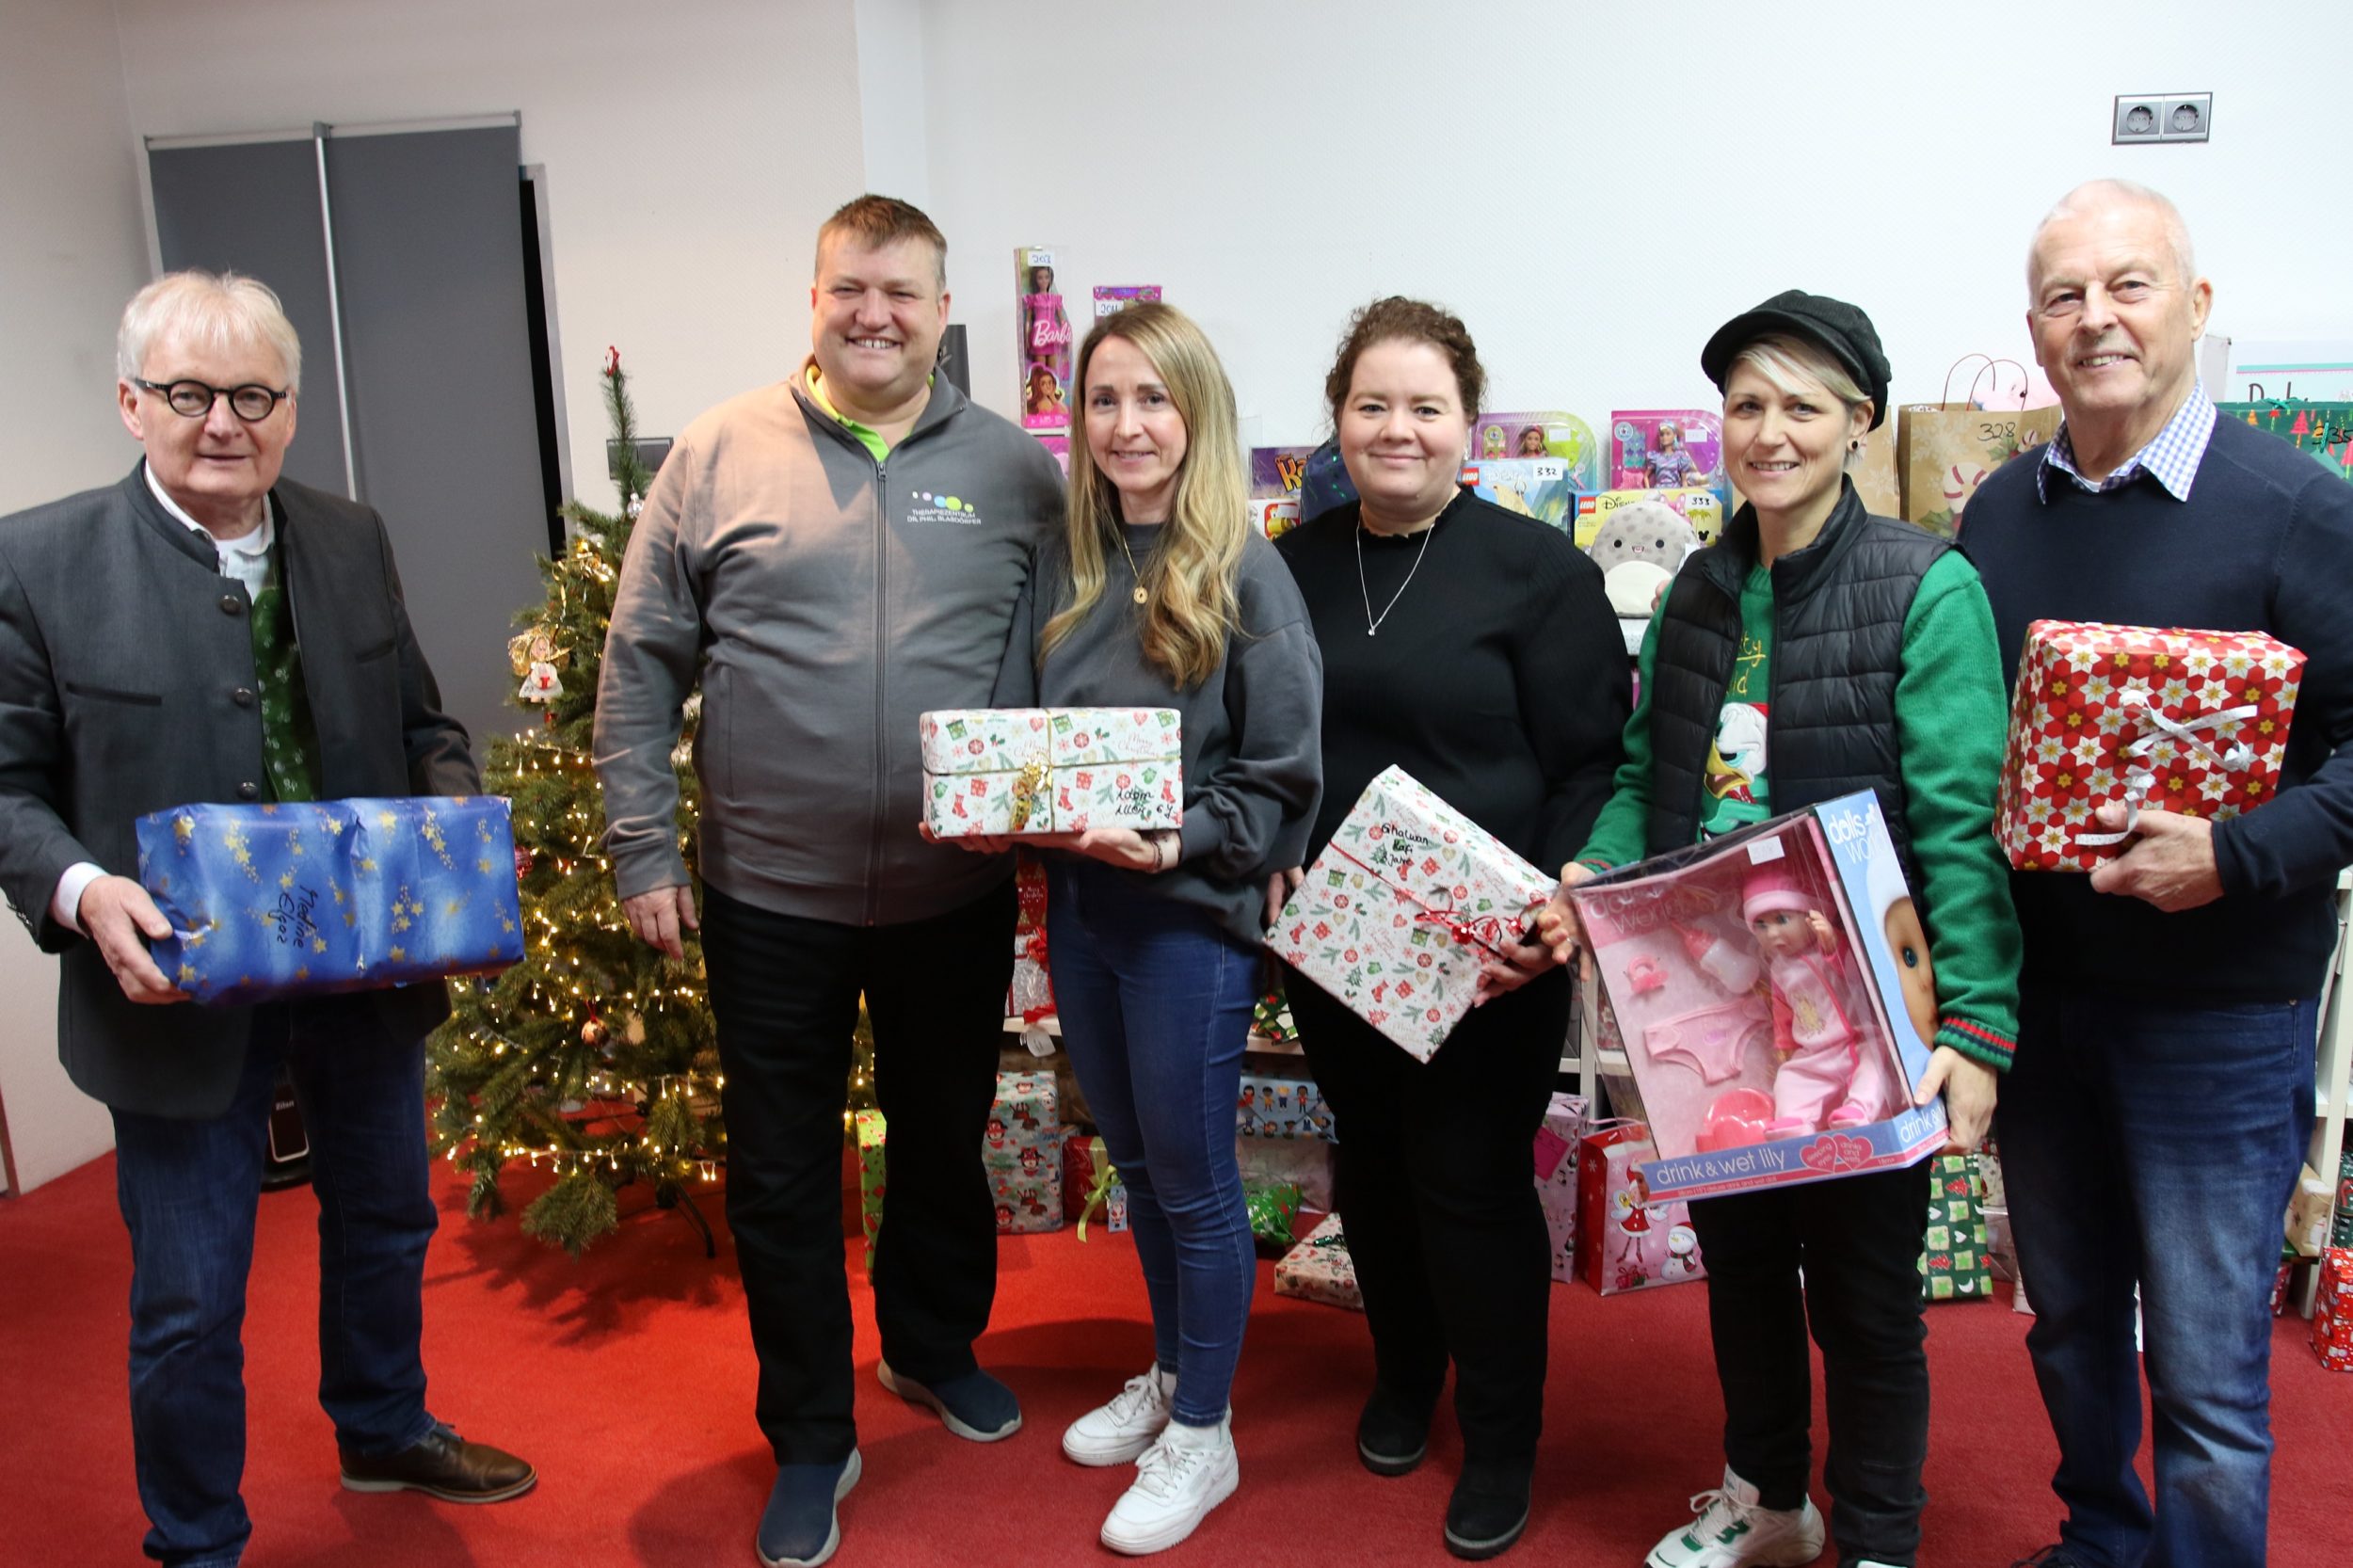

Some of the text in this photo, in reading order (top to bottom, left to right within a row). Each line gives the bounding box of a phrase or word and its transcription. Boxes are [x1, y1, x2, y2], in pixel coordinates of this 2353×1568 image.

[1977, 422, 2016, 441] 328
[1461, 472, 1479, 482] LEGO
[1537, 467, 1558, 475] 332
[1578, 501, 1595, 509] LEGO
[1691, 497, 1710, 506] 333
[1829, 809, 1867, 845] dolls
[1900, 1110, 1933, 1144] drink
[1657, 1146, 1785, 1185] drink & wet lily
